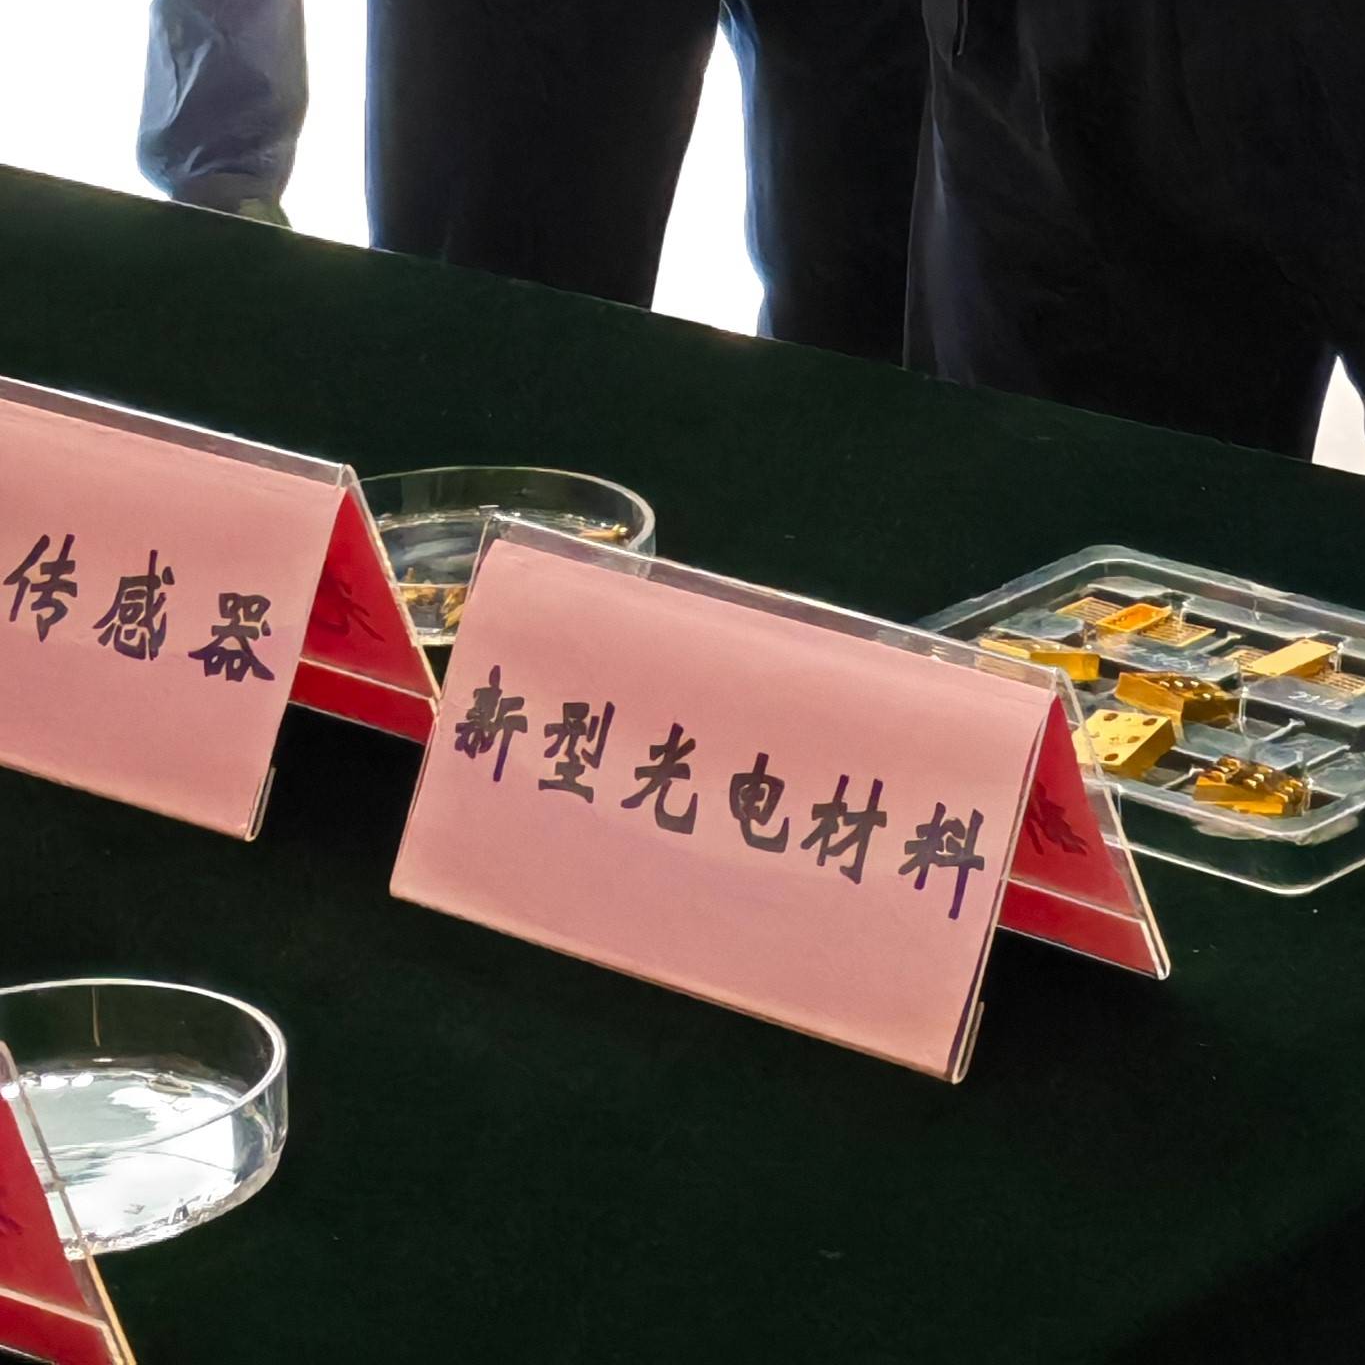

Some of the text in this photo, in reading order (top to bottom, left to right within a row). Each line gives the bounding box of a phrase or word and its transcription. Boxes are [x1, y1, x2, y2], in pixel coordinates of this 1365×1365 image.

[3, 534, 275, 682] 传感器
[452, 665, 987, 920] 新型光电材料
